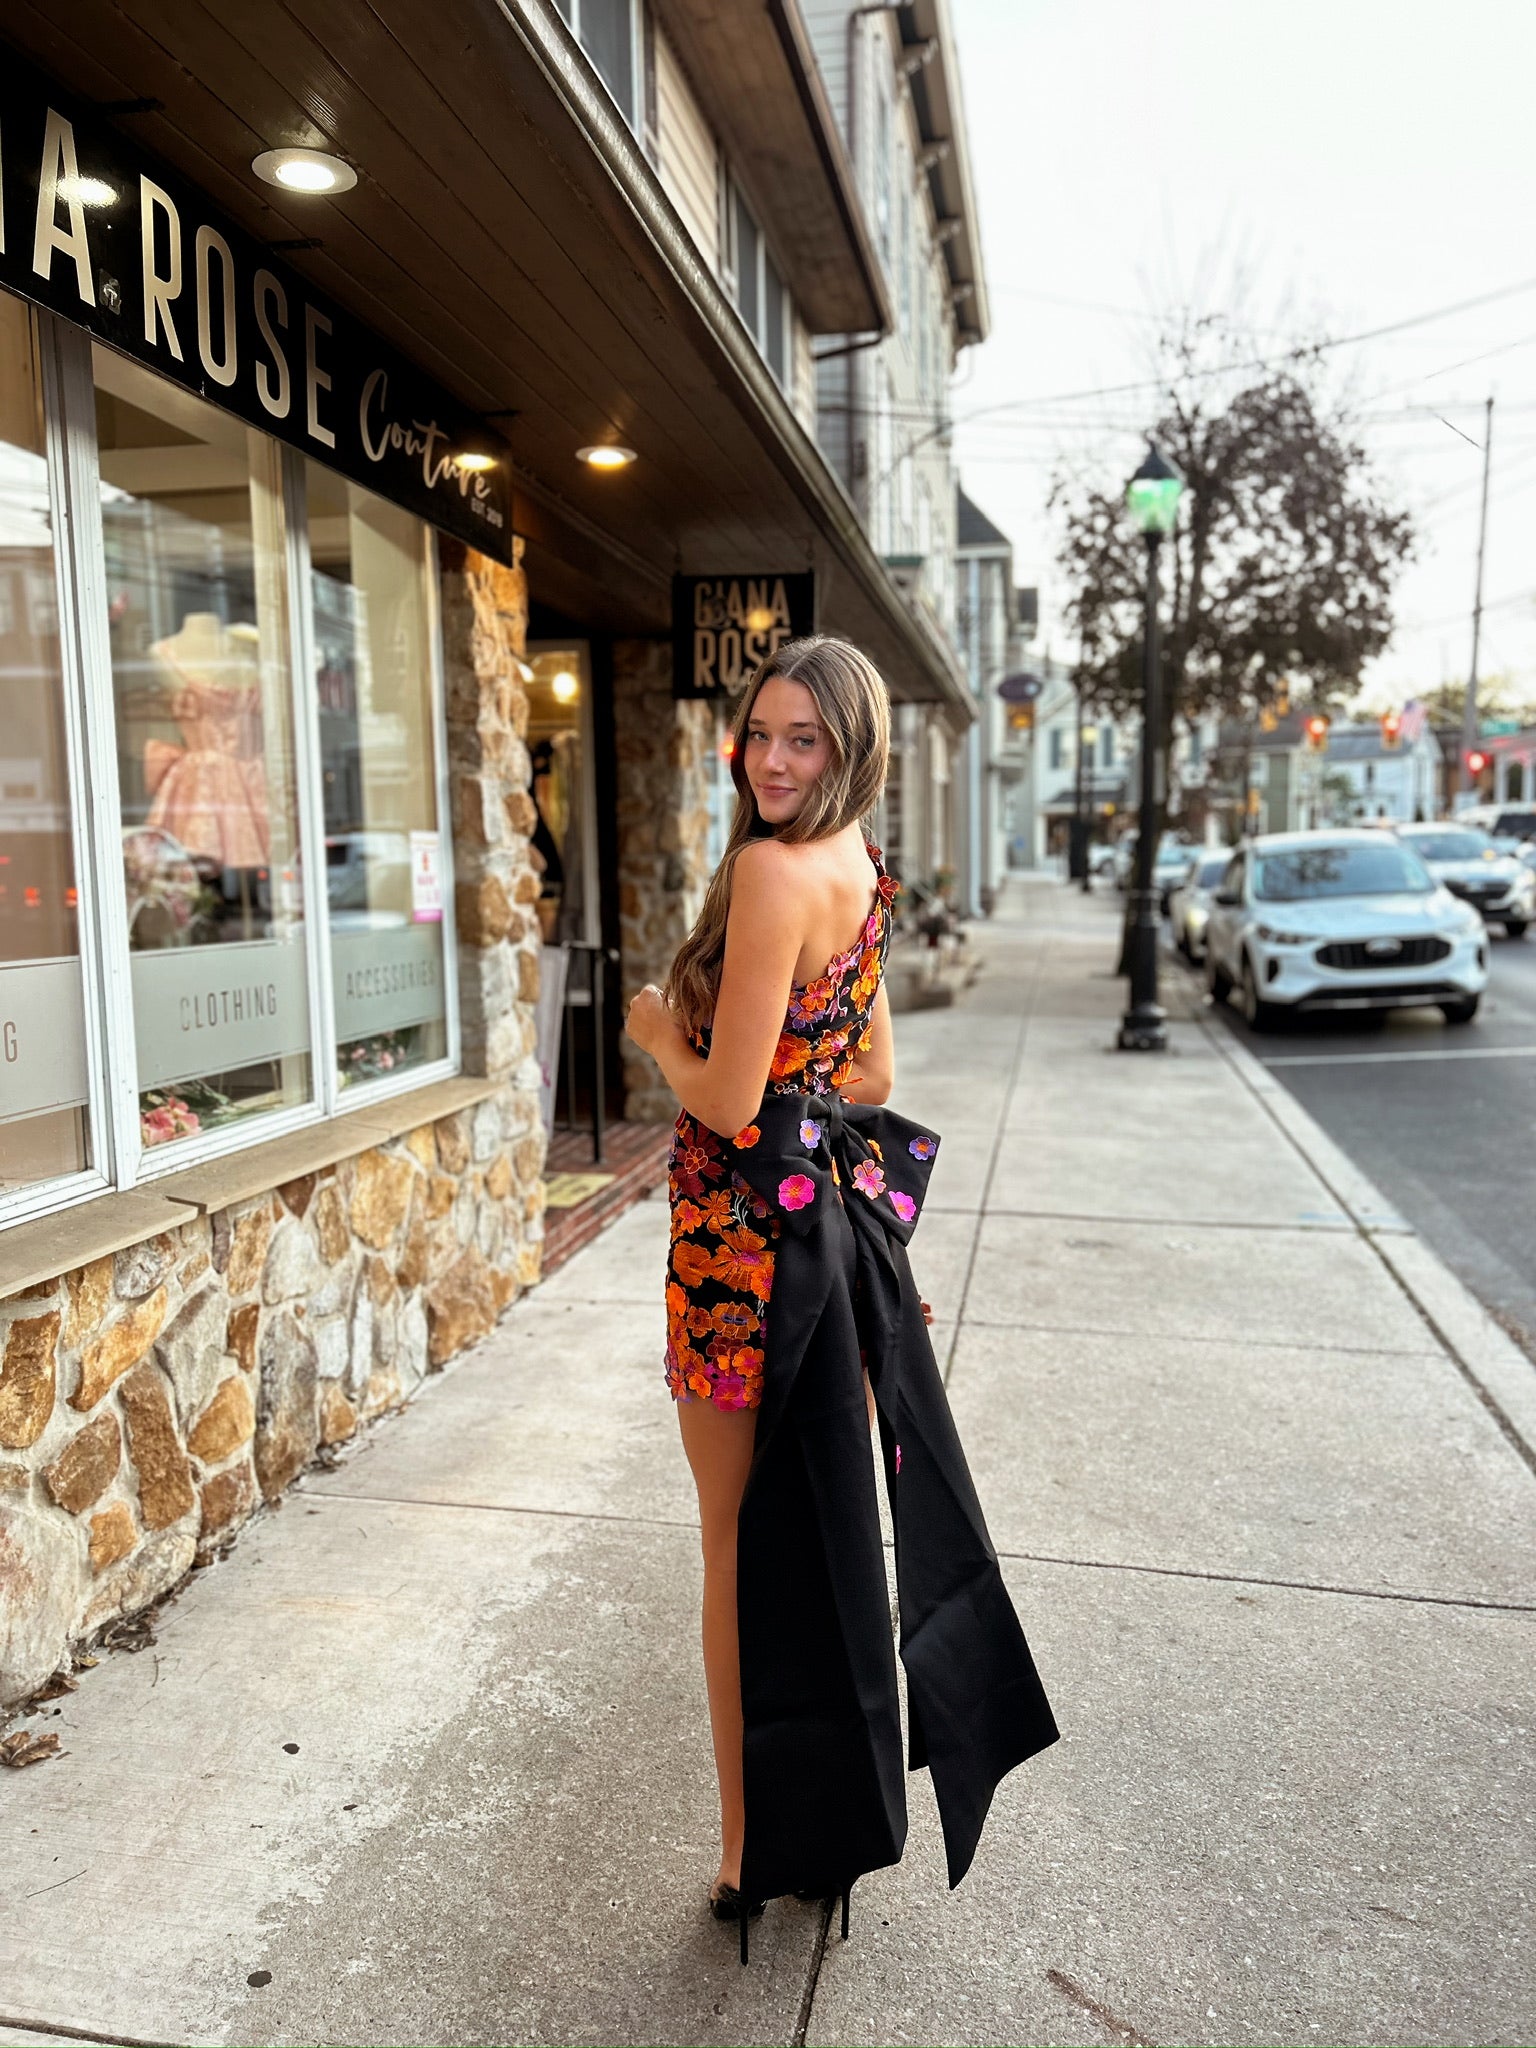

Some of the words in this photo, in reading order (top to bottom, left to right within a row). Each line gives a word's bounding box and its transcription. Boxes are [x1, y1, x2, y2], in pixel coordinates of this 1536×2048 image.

[0, 107, 96, 308] A
[140, 173, 336, 450] ROSE
[360, 368, 491, 498] Couture
[346, 960, 436, 1000] ACCESSORIES
[180, 983, 277, 1032] CLOTHING
[4, 1021, 17, 1063] G
